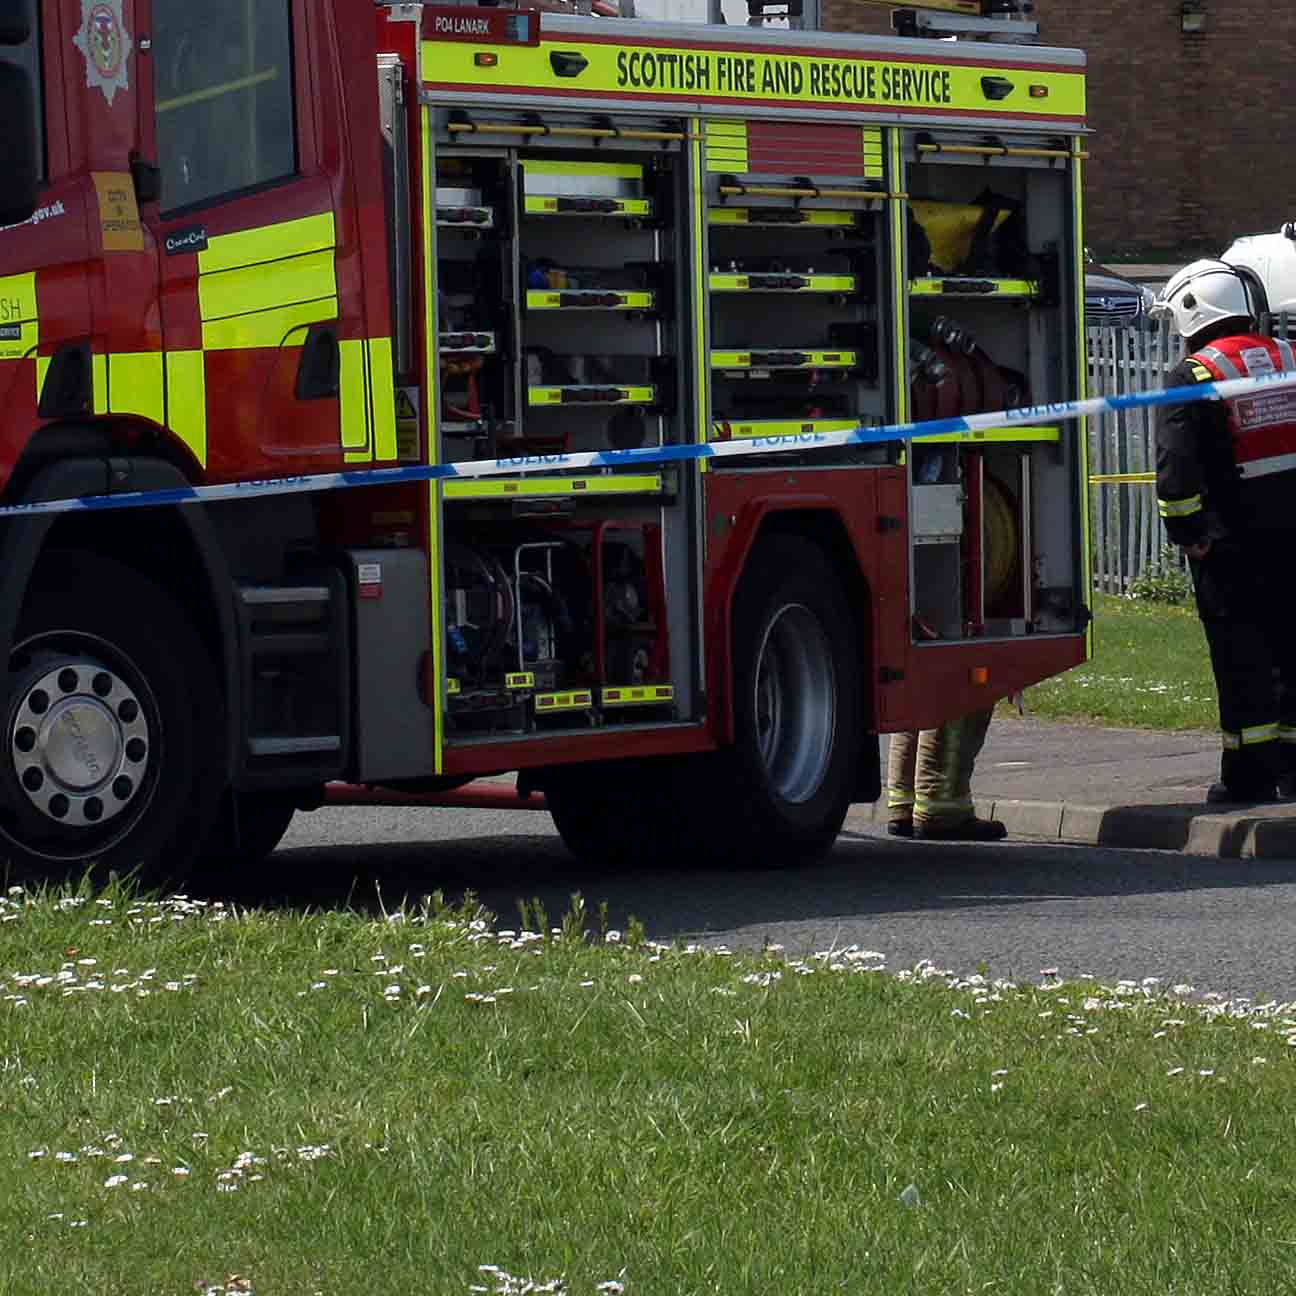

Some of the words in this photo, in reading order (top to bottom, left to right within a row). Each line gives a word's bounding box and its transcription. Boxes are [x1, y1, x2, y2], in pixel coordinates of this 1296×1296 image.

[454, 17, 489, 34] LANARK
[617, 51, 711, 91] SCOTTISH
[717, 56, 755, 93] FIRE
[762, 59, 803, 95] AND
[810, 63, 876, 99] RESCUE
[881, 65, 951, 104] SERVICE
